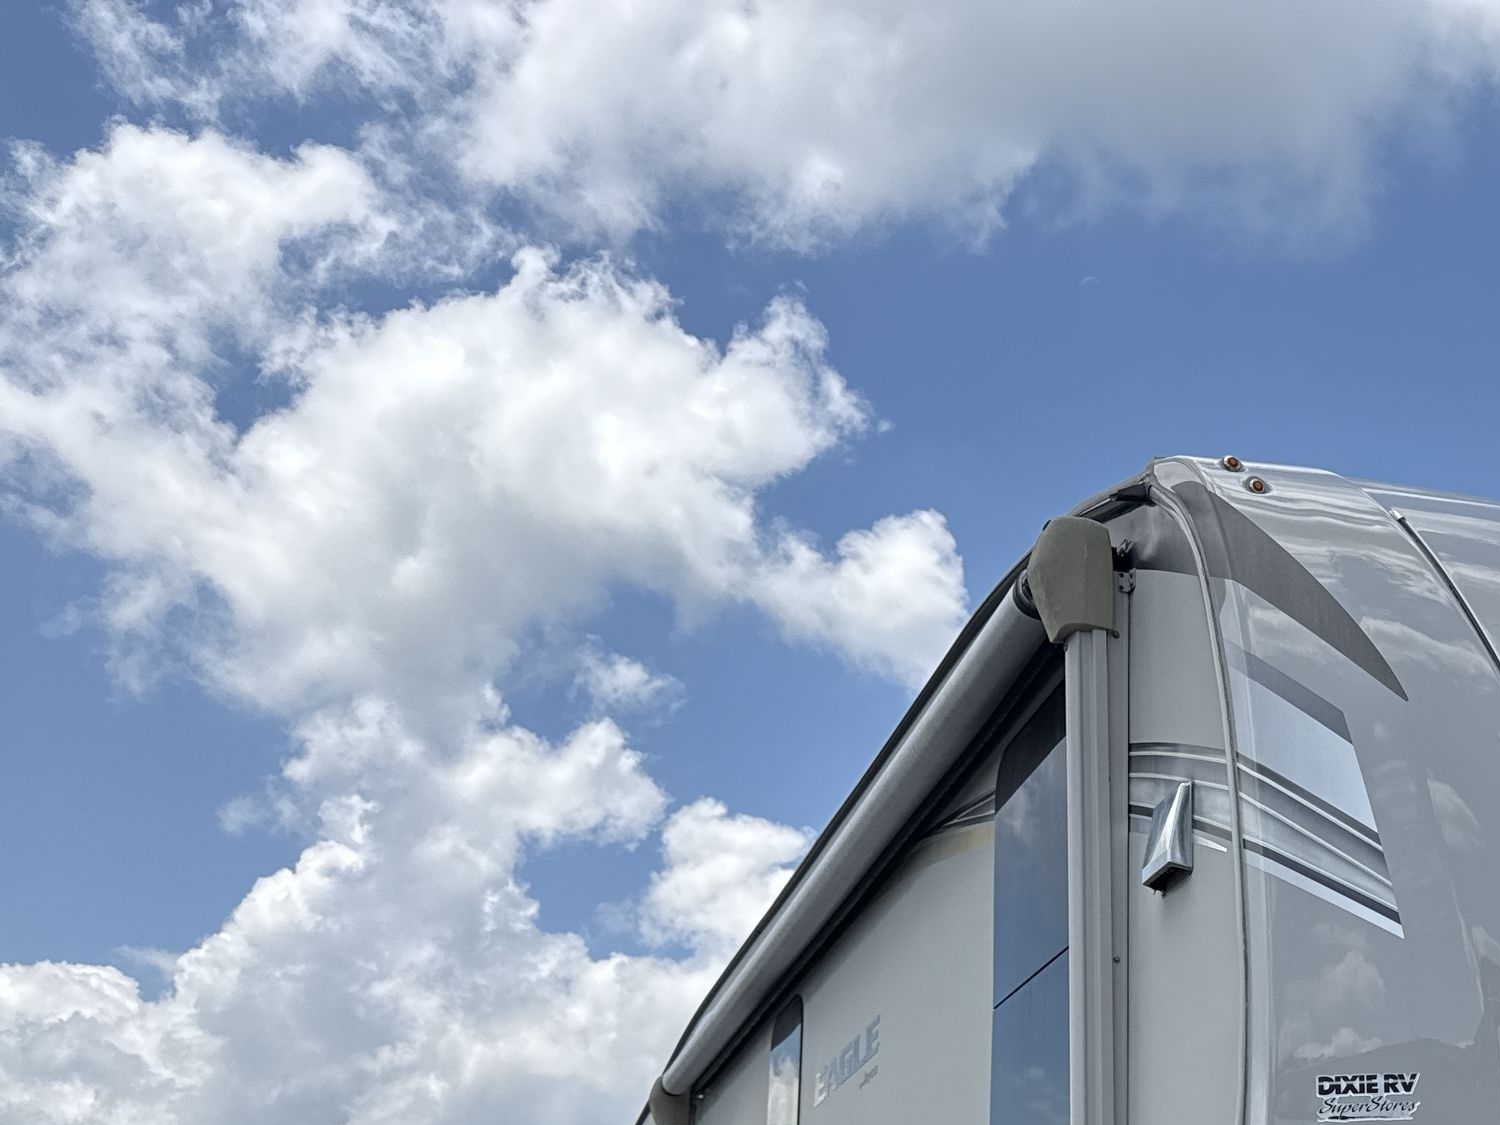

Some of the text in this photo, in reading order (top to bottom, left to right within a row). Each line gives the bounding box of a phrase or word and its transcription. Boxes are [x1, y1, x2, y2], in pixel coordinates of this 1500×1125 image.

[813, 1014, 881, 1108] EAGLE
[1317, 1073, 1417, 1095] DIXIE RV
[1318, 1096, 1417, 1117] SuperStores
